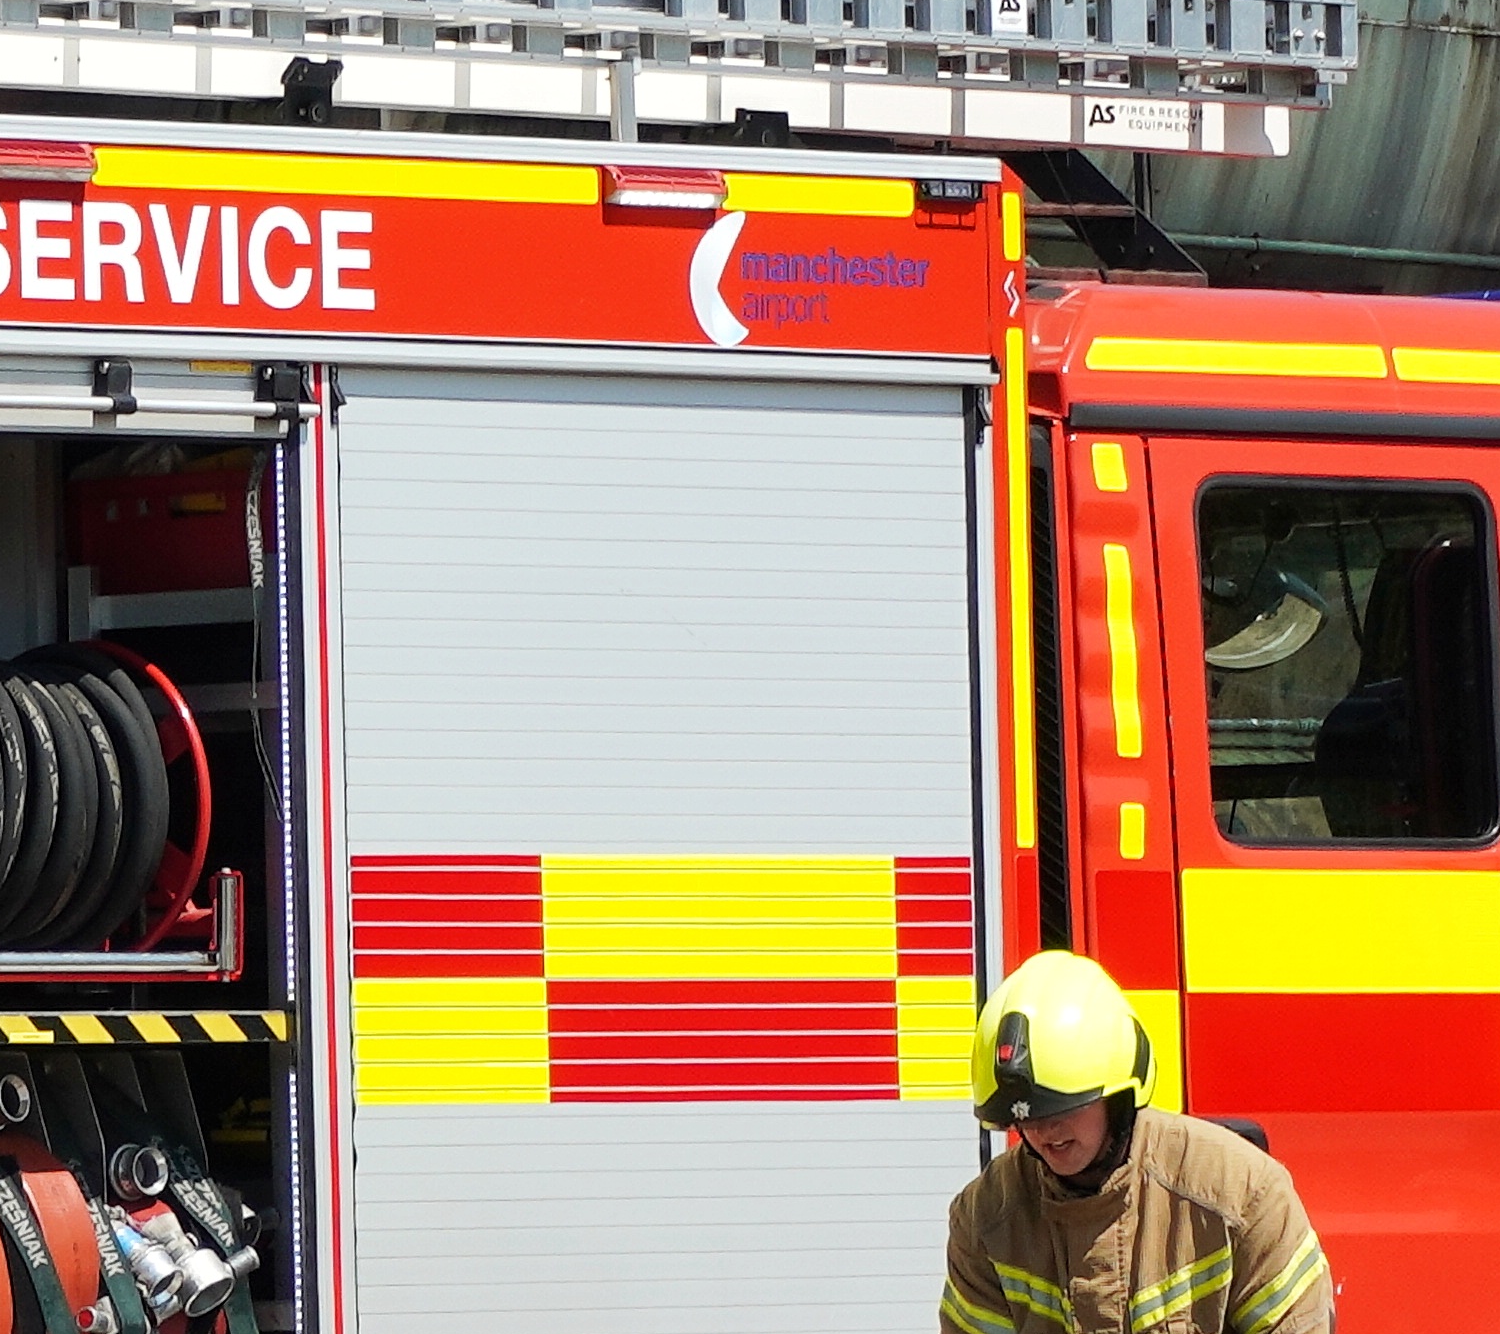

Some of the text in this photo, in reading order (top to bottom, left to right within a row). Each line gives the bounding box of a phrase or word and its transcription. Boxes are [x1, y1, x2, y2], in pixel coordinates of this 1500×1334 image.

[1089, 104, 1116, 127] AS
[1119, 105, 1145, 117] FIRE
[1128, 119, 1197, 133] EQUIPMENT
[741, 247, 931, 288] manchester
[742, 289, 831, 328] airport
